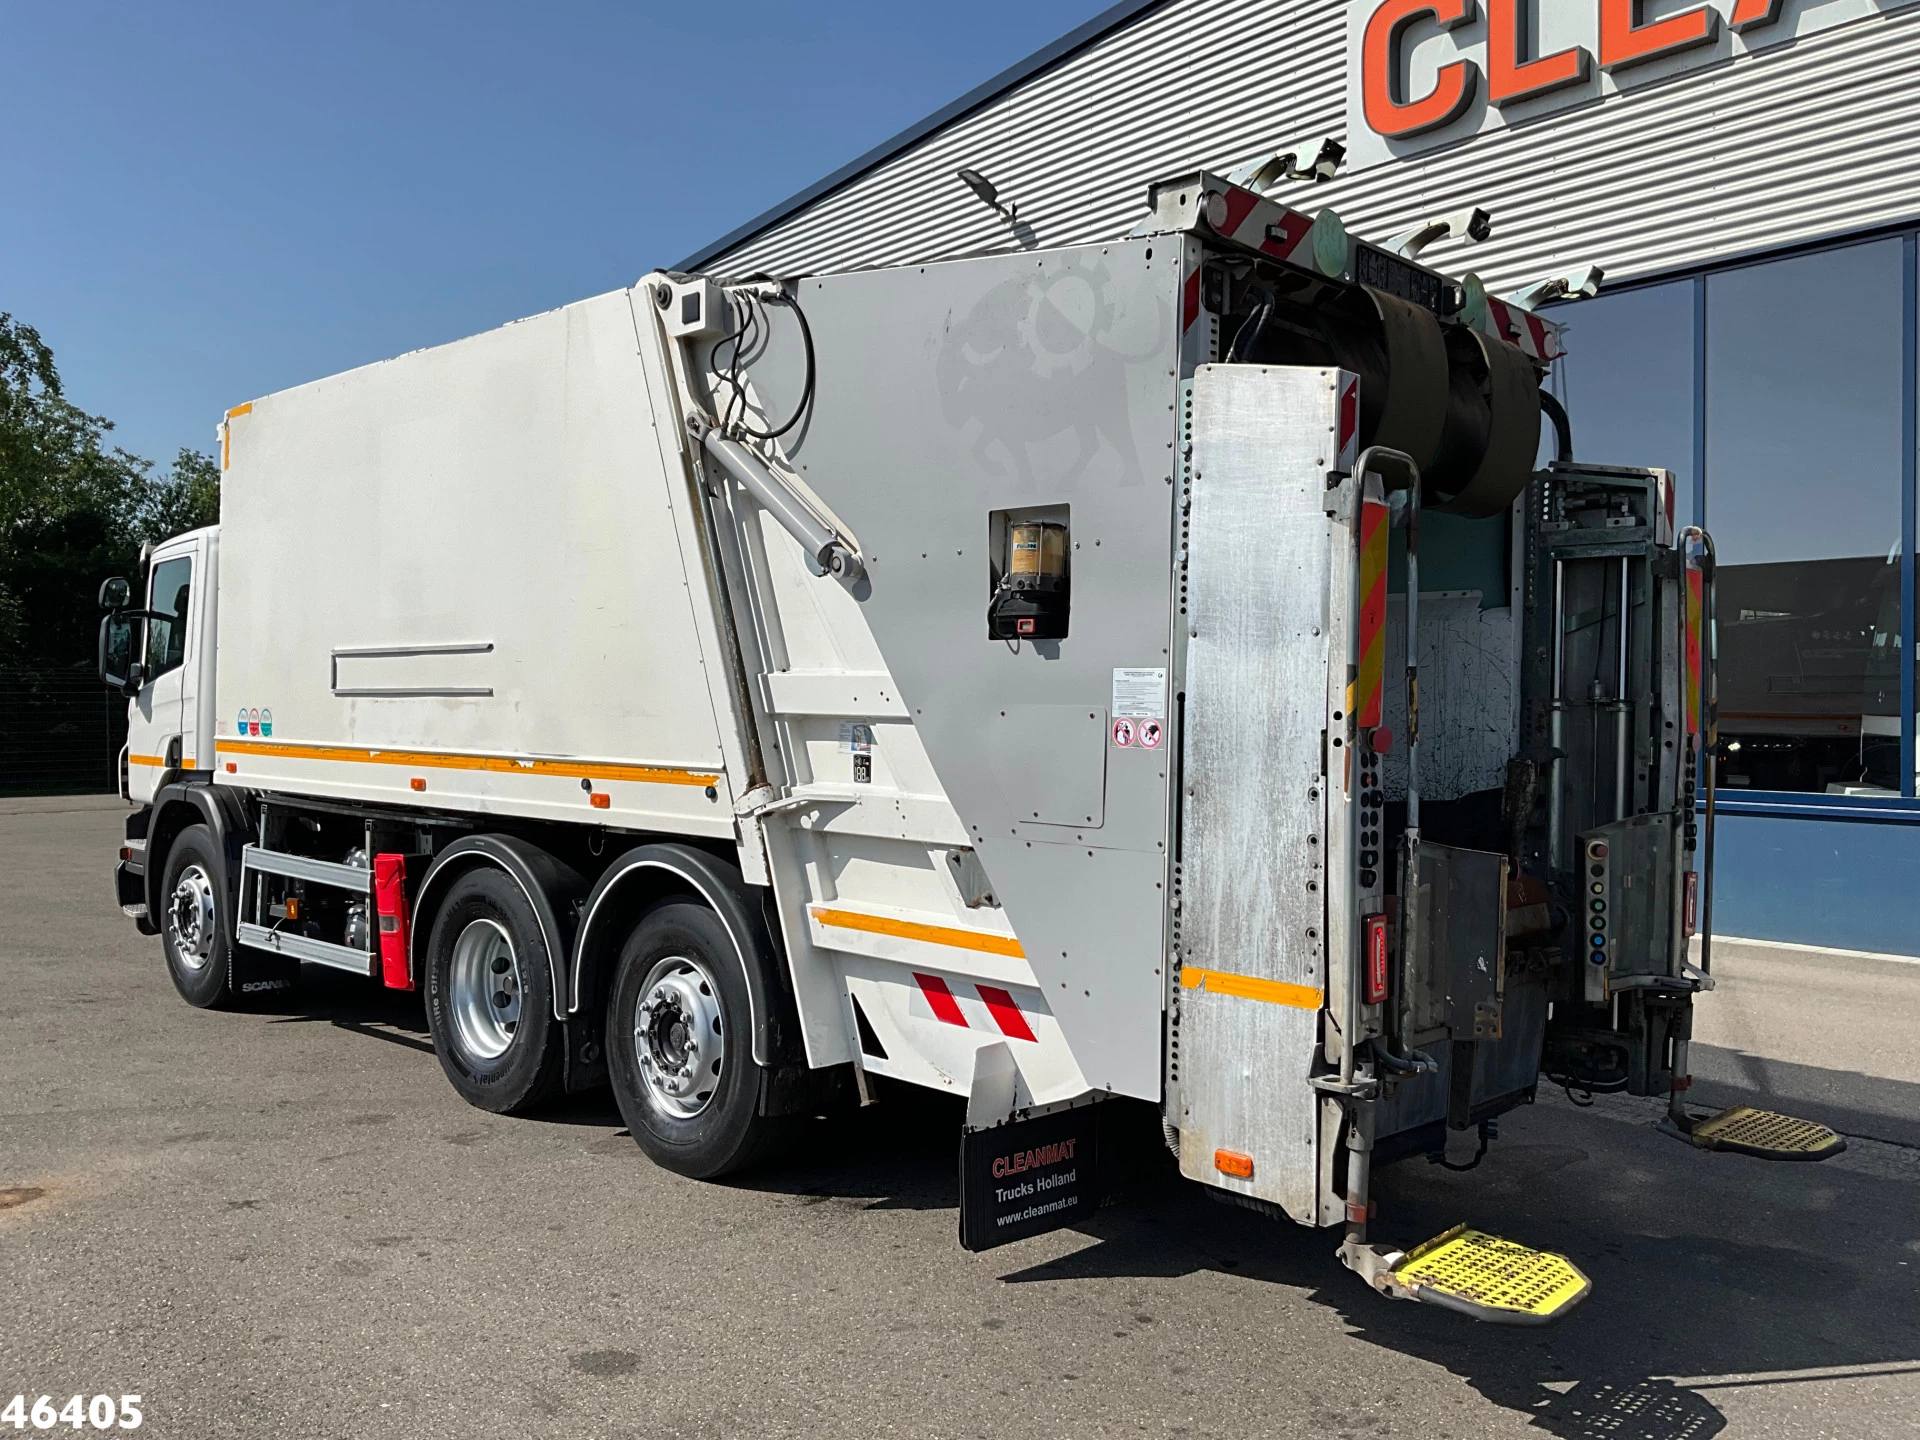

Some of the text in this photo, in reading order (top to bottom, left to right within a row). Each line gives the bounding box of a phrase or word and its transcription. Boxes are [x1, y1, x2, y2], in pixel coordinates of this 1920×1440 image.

[242, 979, 291, 992] SCANIA
[992, 1138, 1076, 1179] CLEANMAT
[995, 1168, 1076, 1203] Trucks Holland
[996, 1195, 1078, 1227] www.cleanmat.eu
